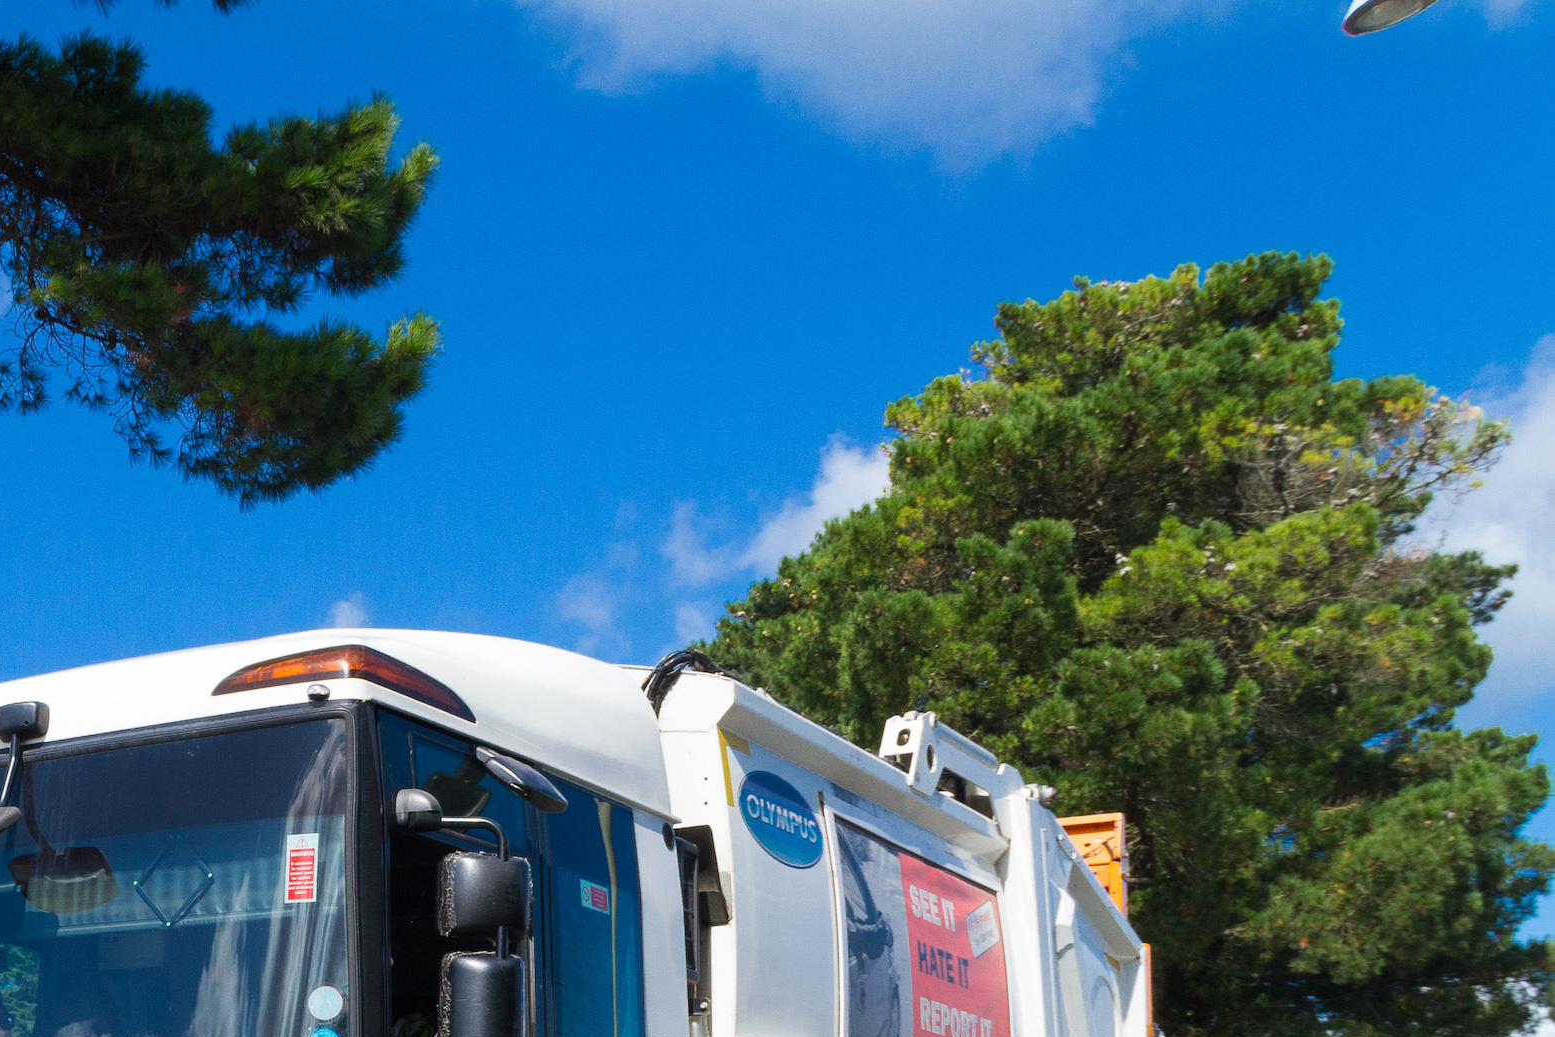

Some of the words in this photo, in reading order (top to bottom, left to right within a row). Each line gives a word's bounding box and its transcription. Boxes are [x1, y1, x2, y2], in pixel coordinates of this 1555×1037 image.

[747, 794, 817, 844] OLYMPUS
[909, 884, 942, 926] SEE
[941, 898, 956, 932] IT
[917, 940, 955, 985] HATE
[957, 956, 969, 989] IT
